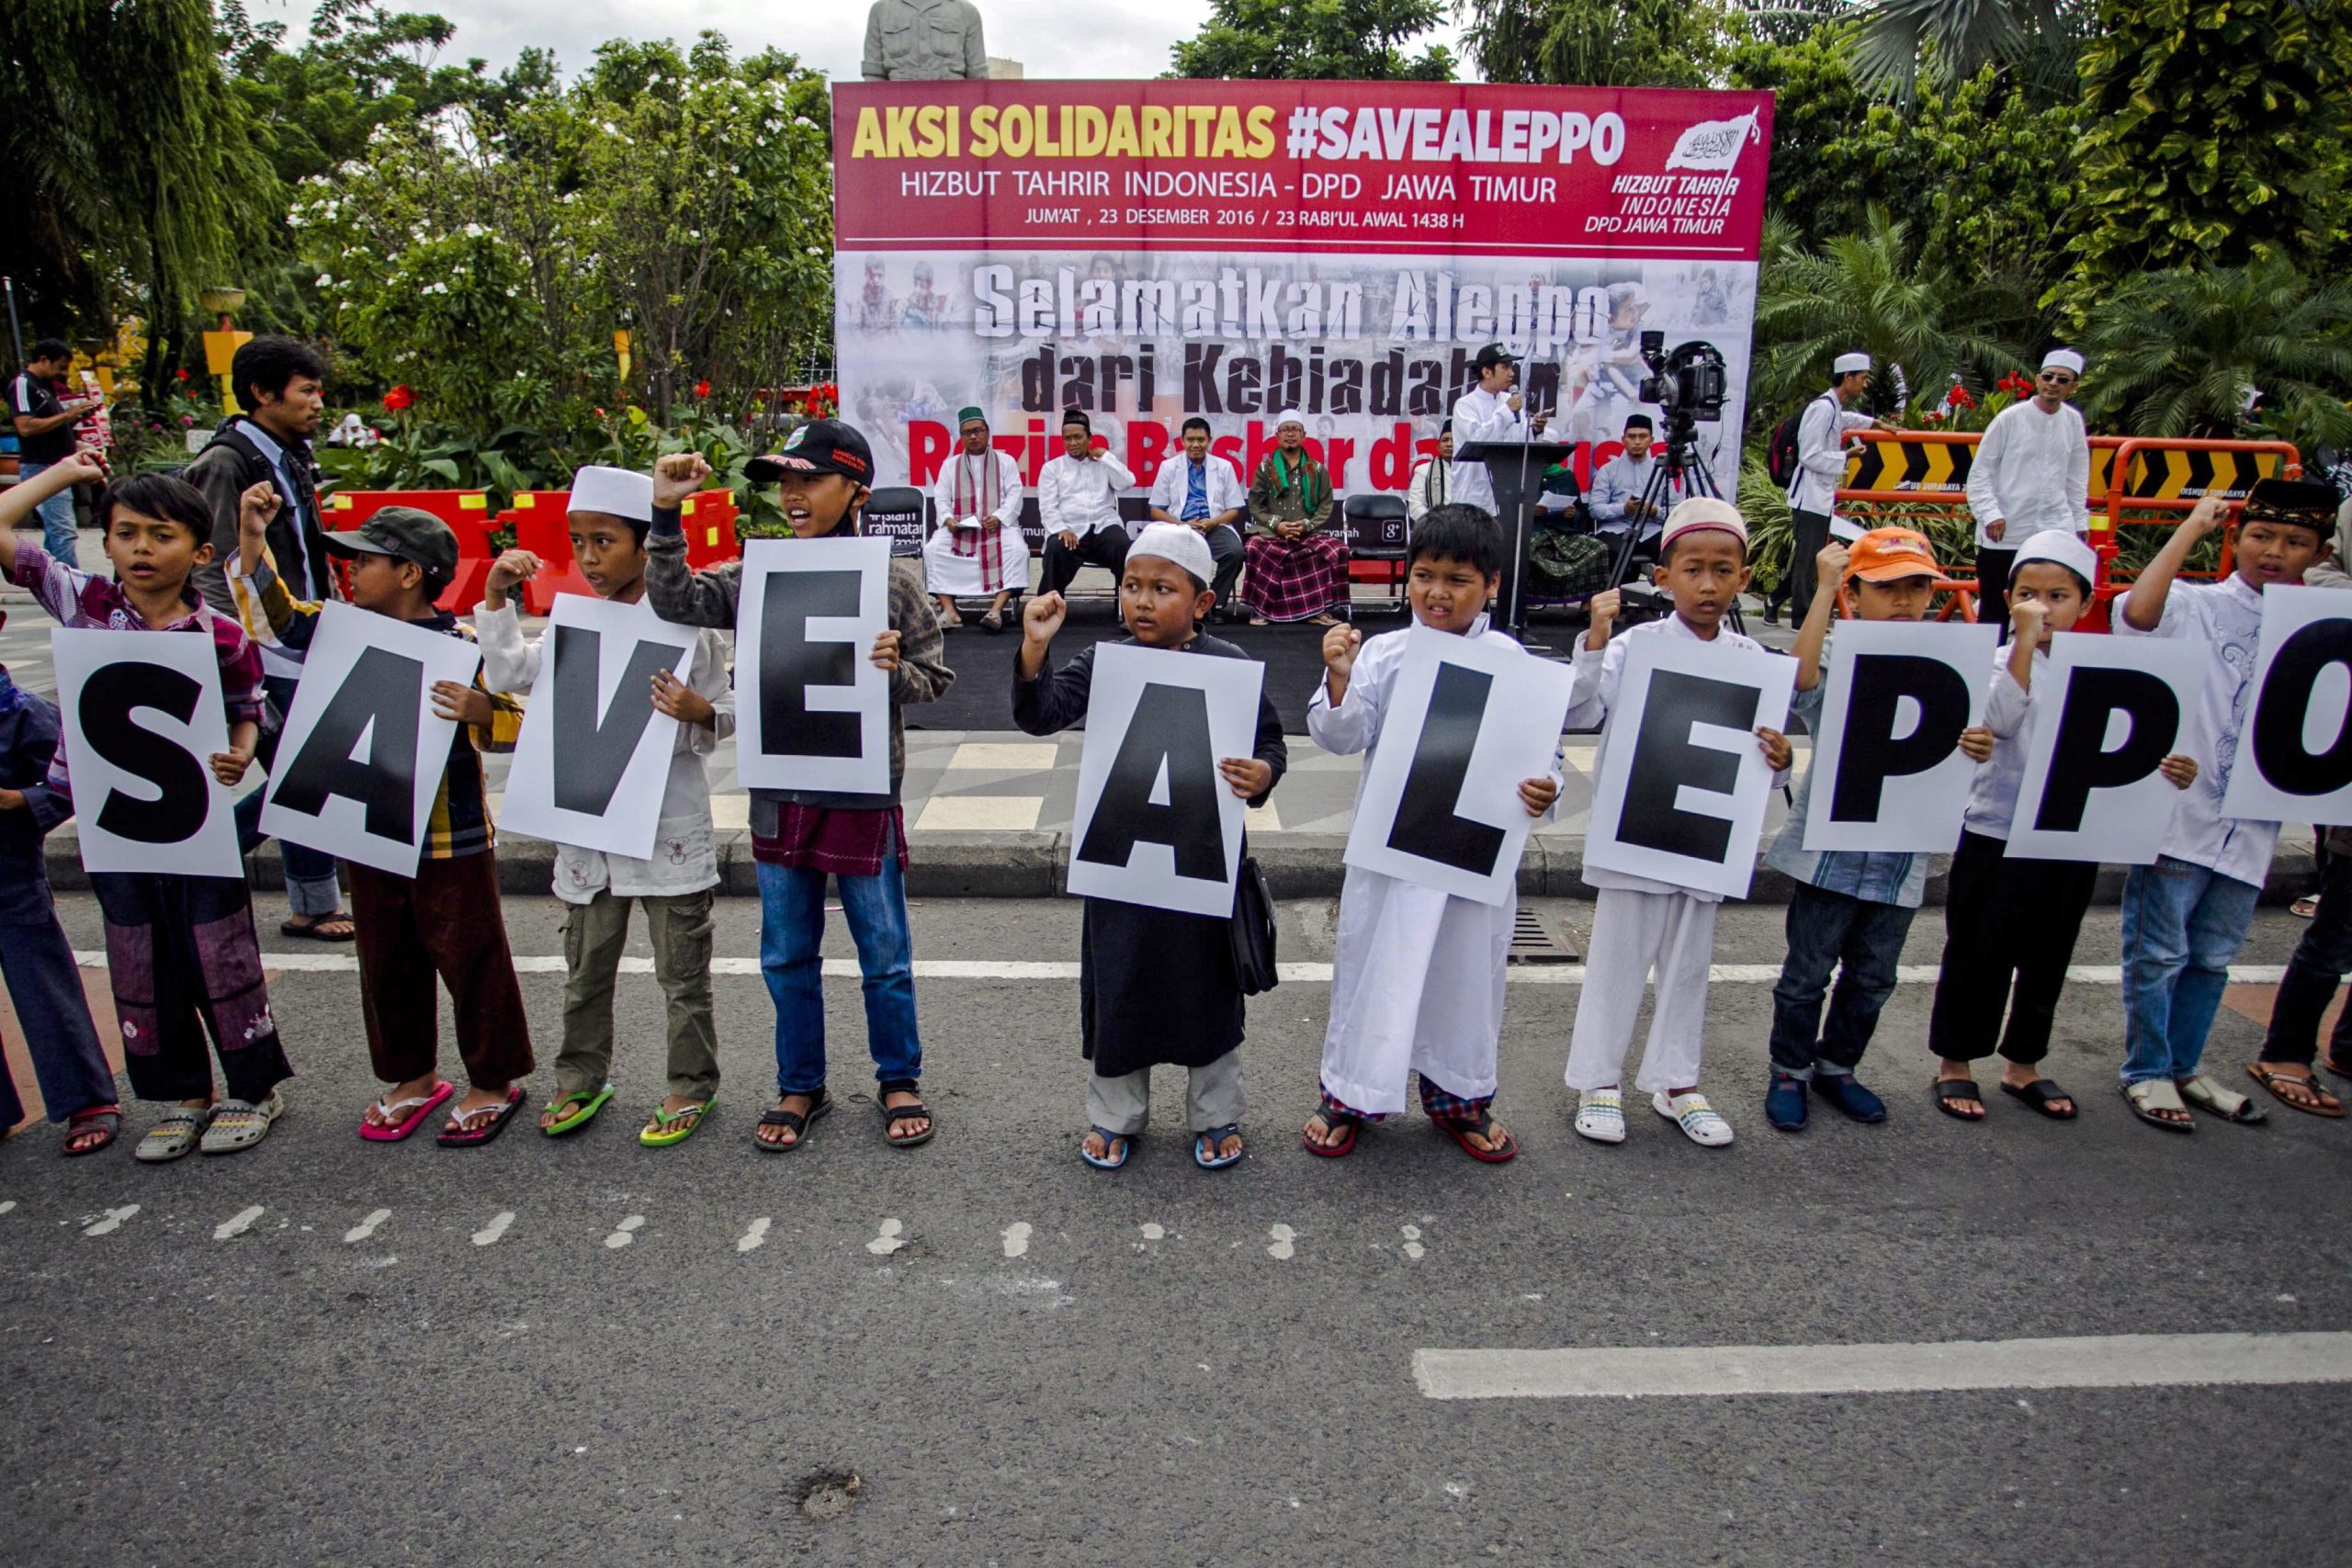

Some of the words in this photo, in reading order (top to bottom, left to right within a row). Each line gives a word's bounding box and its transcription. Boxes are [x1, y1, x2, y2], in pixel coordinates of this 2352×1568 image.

[852, 105, 960, 159] AKSI
[969, 103, 1276, 160] SOLIDARITAS
[1287, 106, 1625, 165] #SAVEALEPPO
[900, 171, 1001, 197] HIZBUT
[1012, 171, 1111, 197] TAHRIR
[1125, 171, 1277, 198] INDONESIA
[1302, 173, 1362, 199] DPD
[1381, 174, 1457, 200] JAWA
[1469, 175, 1556, 203] TIMUR
[1611, 175, 1676, 194] HIZBUT
[1677, 176, 1740, 196] TAHRIR
[1620, 197, 1731, 217] INDONESIA
[1099, 209, 1118, 223] 23
[1126, 209, 1209, 224] DESEMBER
[1216, 209, 1255, 225] 2016
[1276, 210, 1295, 226] 23
[1363, 212, 1408, 228] AWAL
[1412, 212, 1449, 228] 1438
[1452, 213, 1464, 228] H
[1584, 216, 1623, 232] DPD
[1623, 217, 1668, 233] JAWA
[1672, 218, 1724, 234] TIMUR
[974, 264, 1364, 340] Selamatkan
[1389, 270, 1611, 357] Aleppo
[1022, 343, 1155, 413] dari
[269, 645, 424, 847] A
[553, 624, 686, 818] V
[759, 570, 864, 759] E
[1829, 653, 1971, 823] P
[2032, 665, 2180, 832] P
[2253, 617, 2352, 796] O
[78, 661, 210, 844] S
[1075, 682, 1229, 884] A
[1385, 660, 1507, 877] L
[1614, 668, 1762, 864] E
